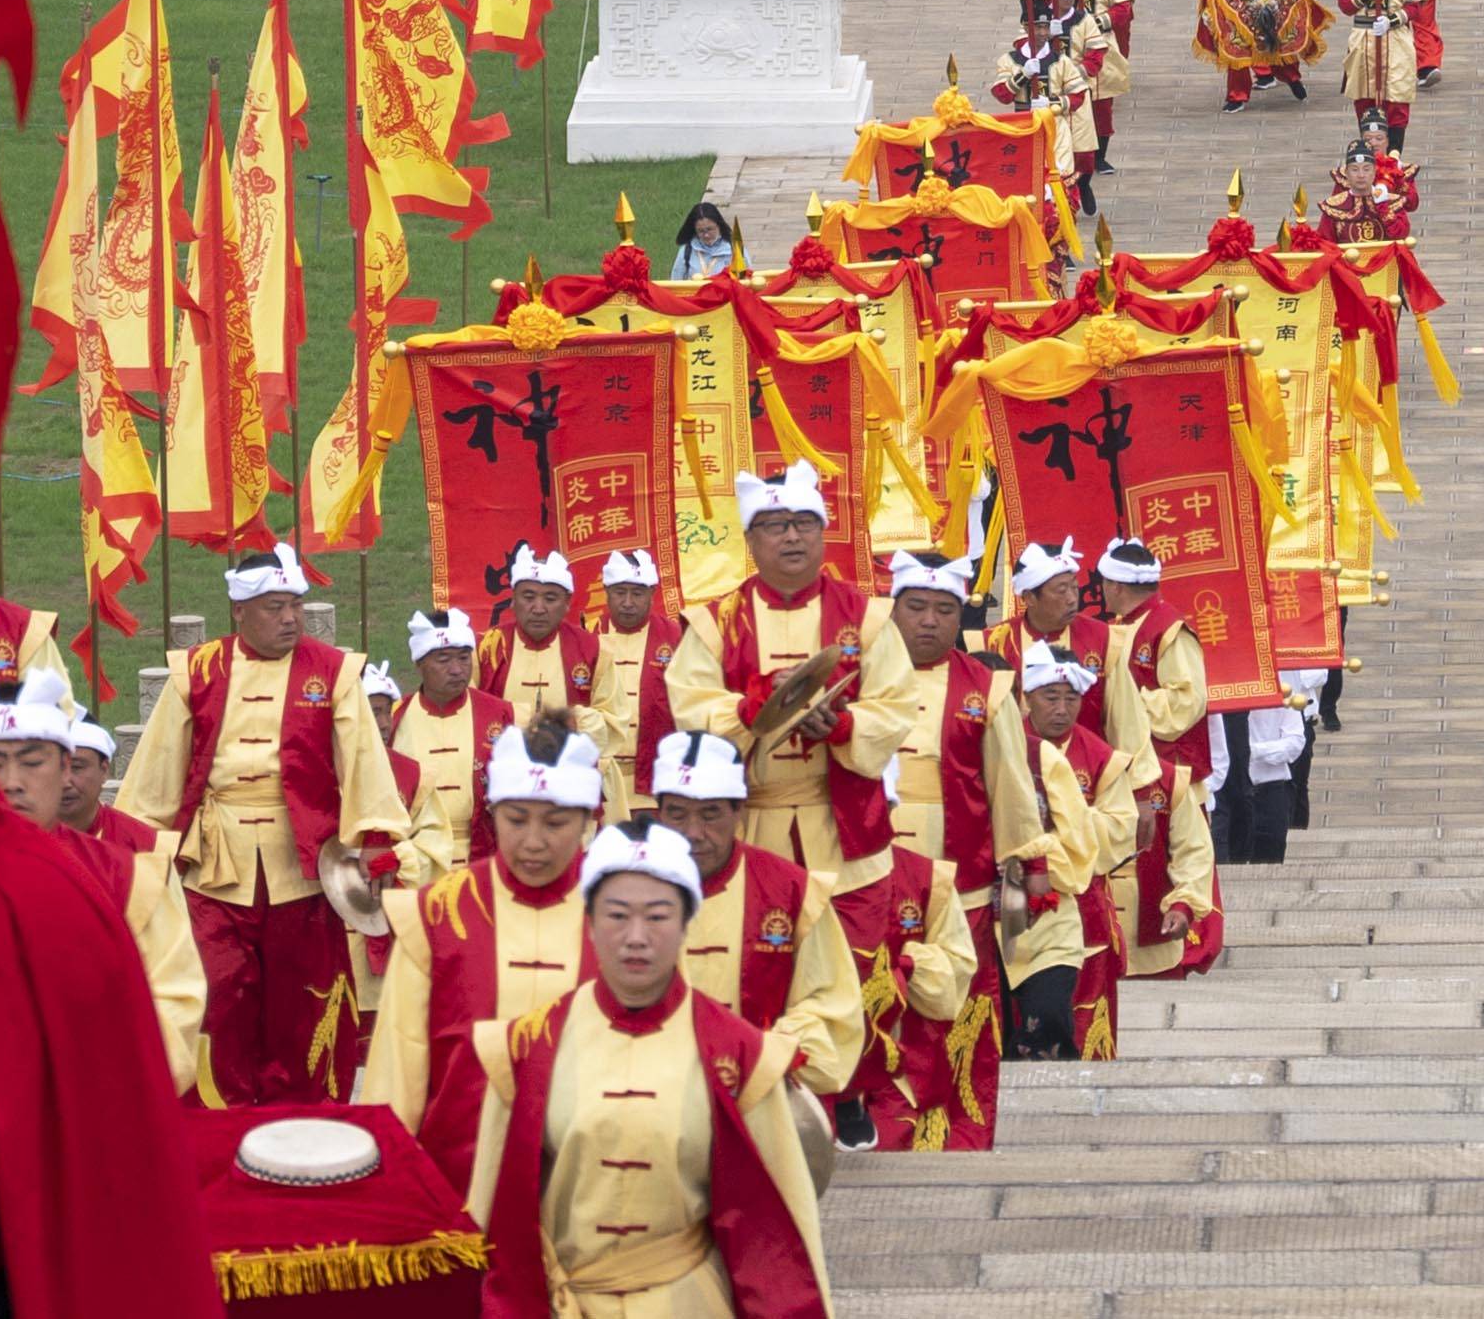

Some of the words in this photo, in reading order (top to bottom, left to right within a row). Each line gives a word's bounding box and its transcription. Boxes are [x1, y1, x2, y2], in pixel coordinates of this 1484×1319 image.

[1276, 297, 1300, 341] 河南
[604, 375, 632, 422] 北京
[1179, 394, 1208, 442] 天津
